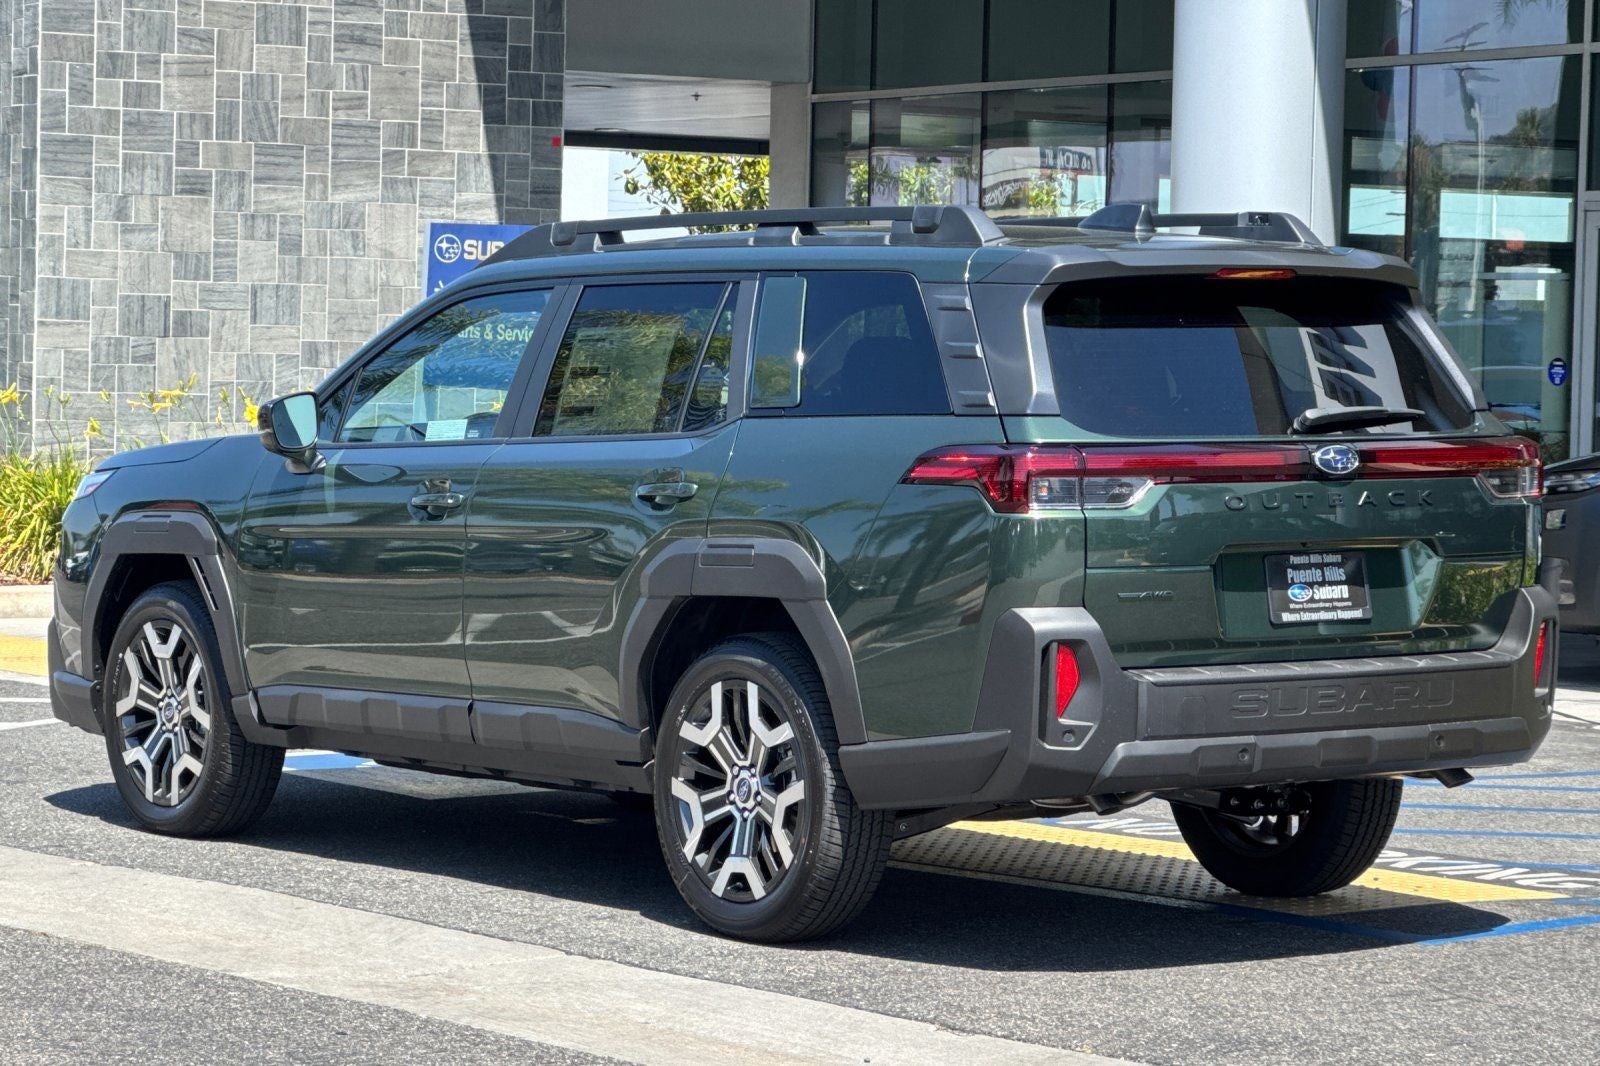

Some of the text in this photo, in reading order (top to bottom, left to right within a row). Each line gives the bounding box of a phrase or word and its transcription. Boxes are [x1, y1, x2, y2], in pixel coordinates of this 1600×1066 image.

[458, 324, 534, 342] arts & Servi
[1224, 490, 1433, 510] OUTBACK
[1323, 553, 1341, 562] Subaru
[1287, 565, 1346, 583] Puente Hills
[1313, 584, 1349, 600] Subaru
[1282, 612, 1300, 621] Where
[1301, 610, 1337, 620] Extraordinary
[1230, 679, 1455, 719] SUBARU
[1375, 849, 1600, 888] KING
